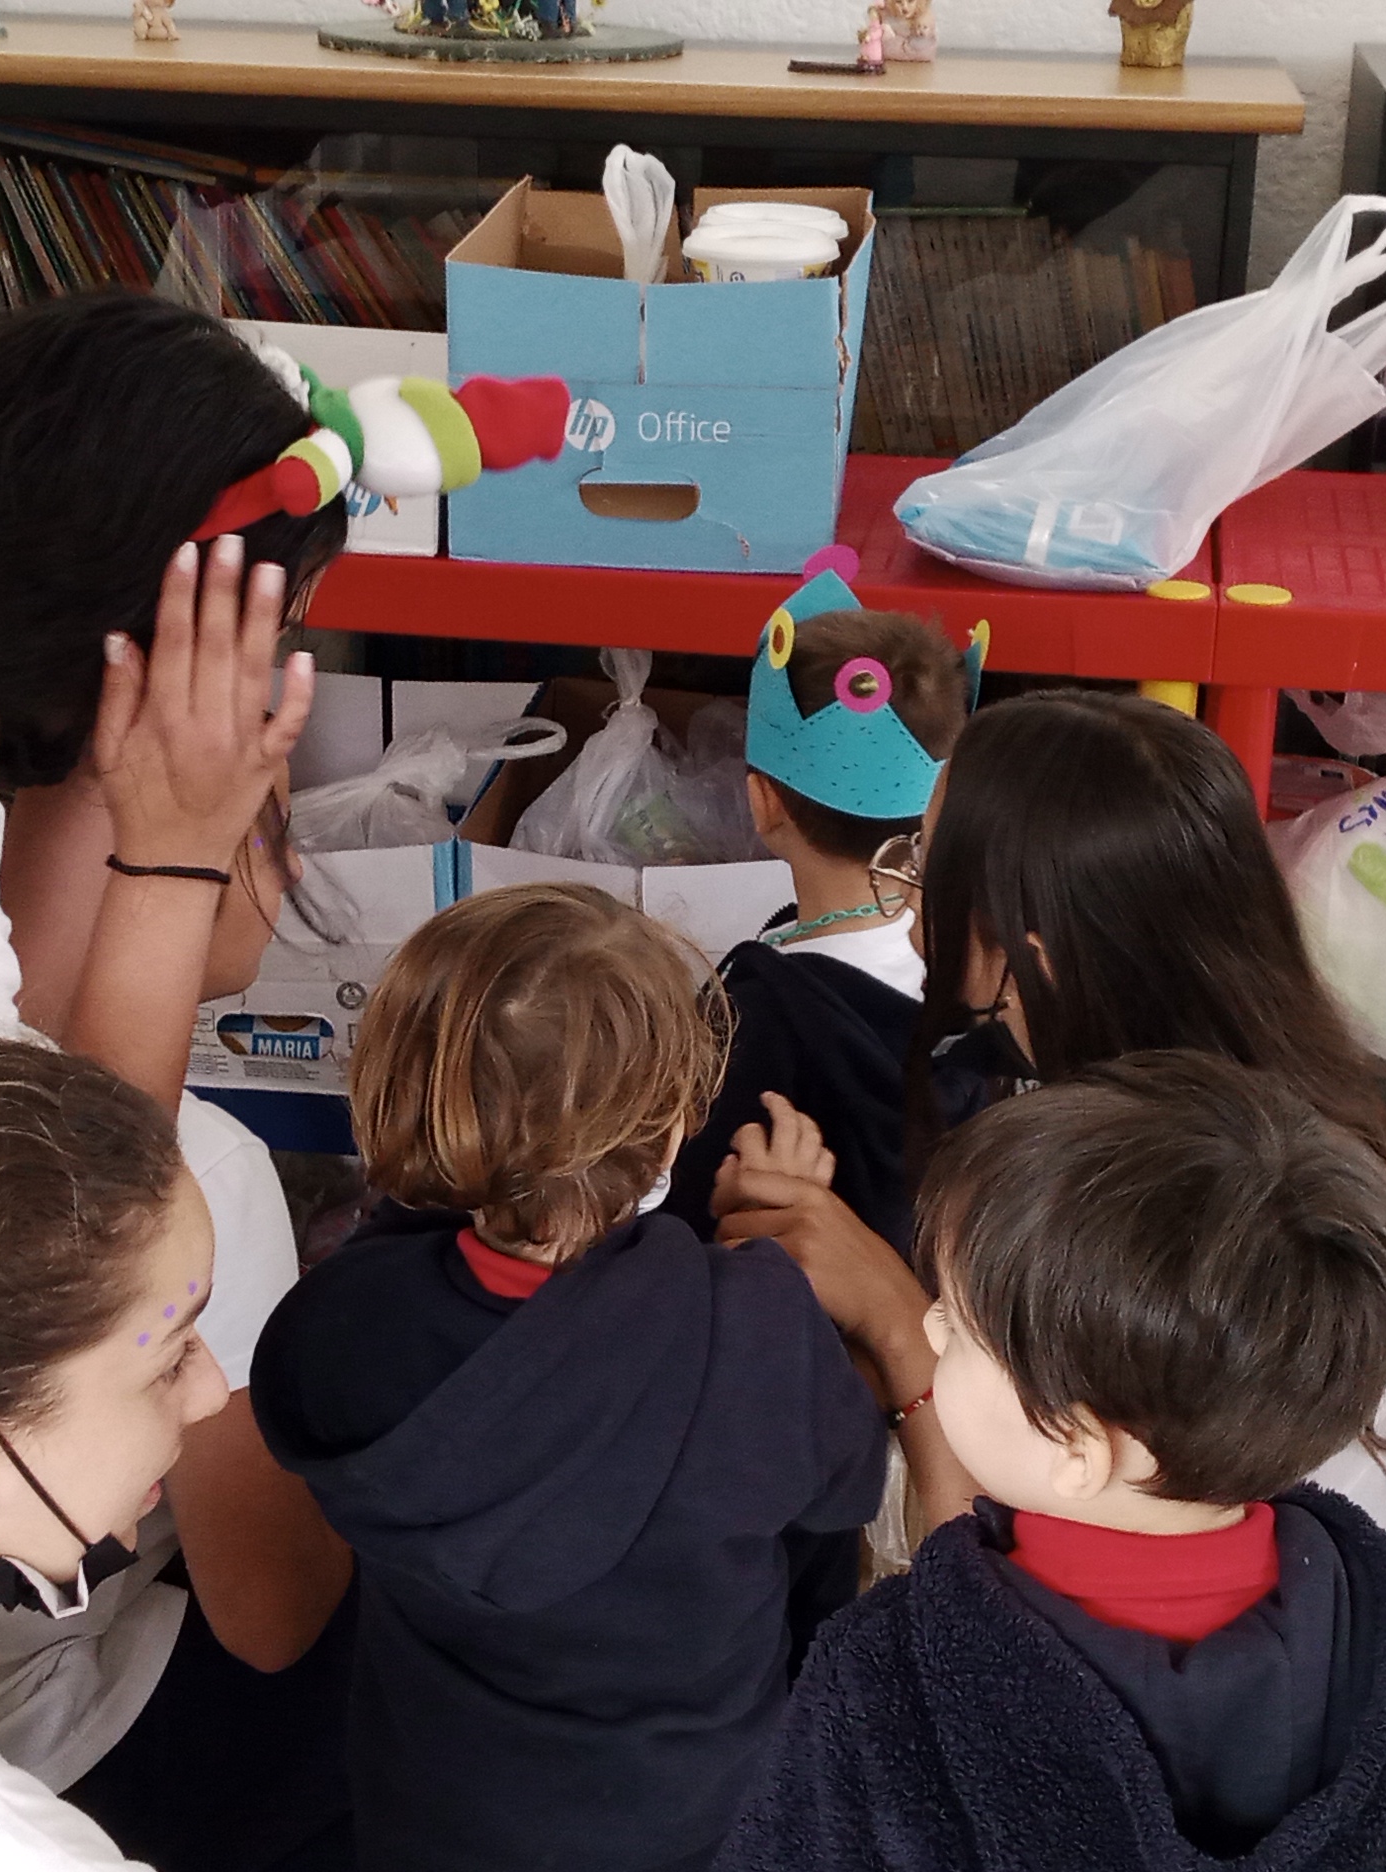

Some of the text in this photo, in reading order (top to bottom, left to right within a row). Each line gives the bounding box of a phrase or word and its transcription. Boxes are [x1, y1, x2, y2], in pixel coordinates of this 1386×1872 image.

[566, 399, 732, 451] hp Office
[257, 1038, 313, 1059] MARIA
